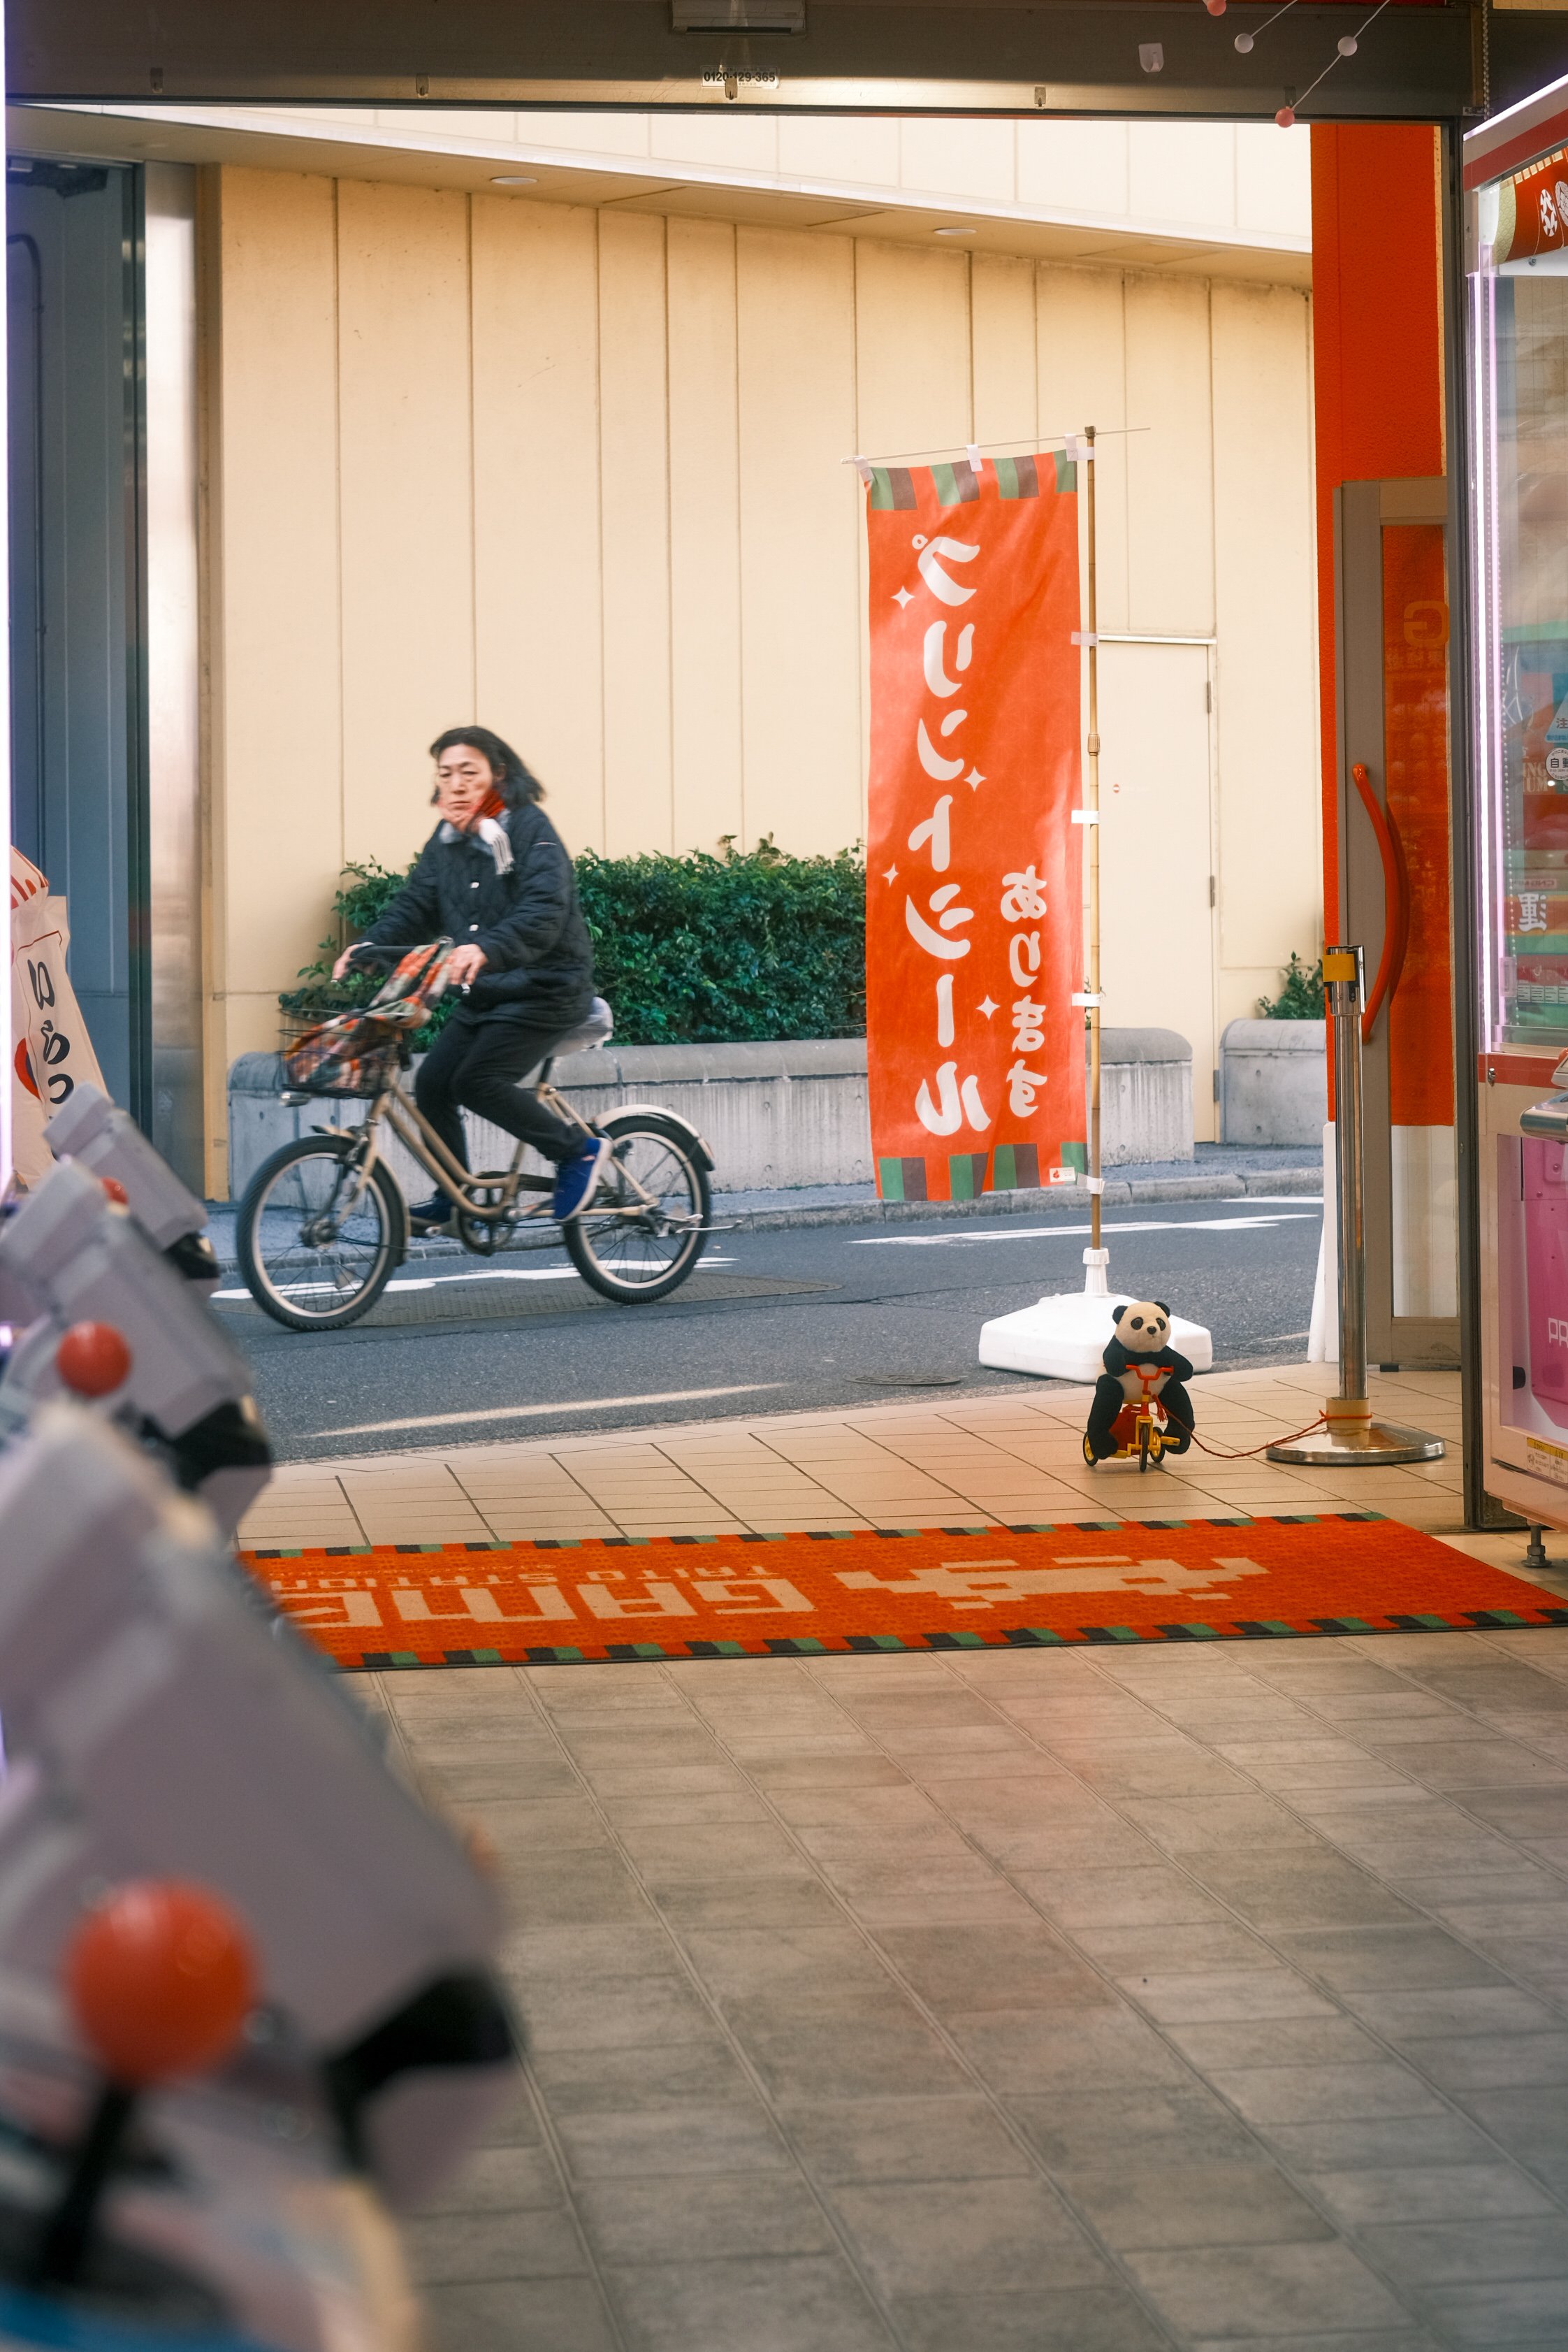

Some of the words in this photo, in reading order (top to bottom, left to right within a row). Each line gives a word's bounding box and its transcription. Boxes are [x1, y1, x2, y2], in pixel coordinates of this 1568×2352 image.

[704, 71, 775, 82] 0120-129-365
[587, 1566, 778, 1581] TAITO
[271, 1573, 557, 1590] STATION
